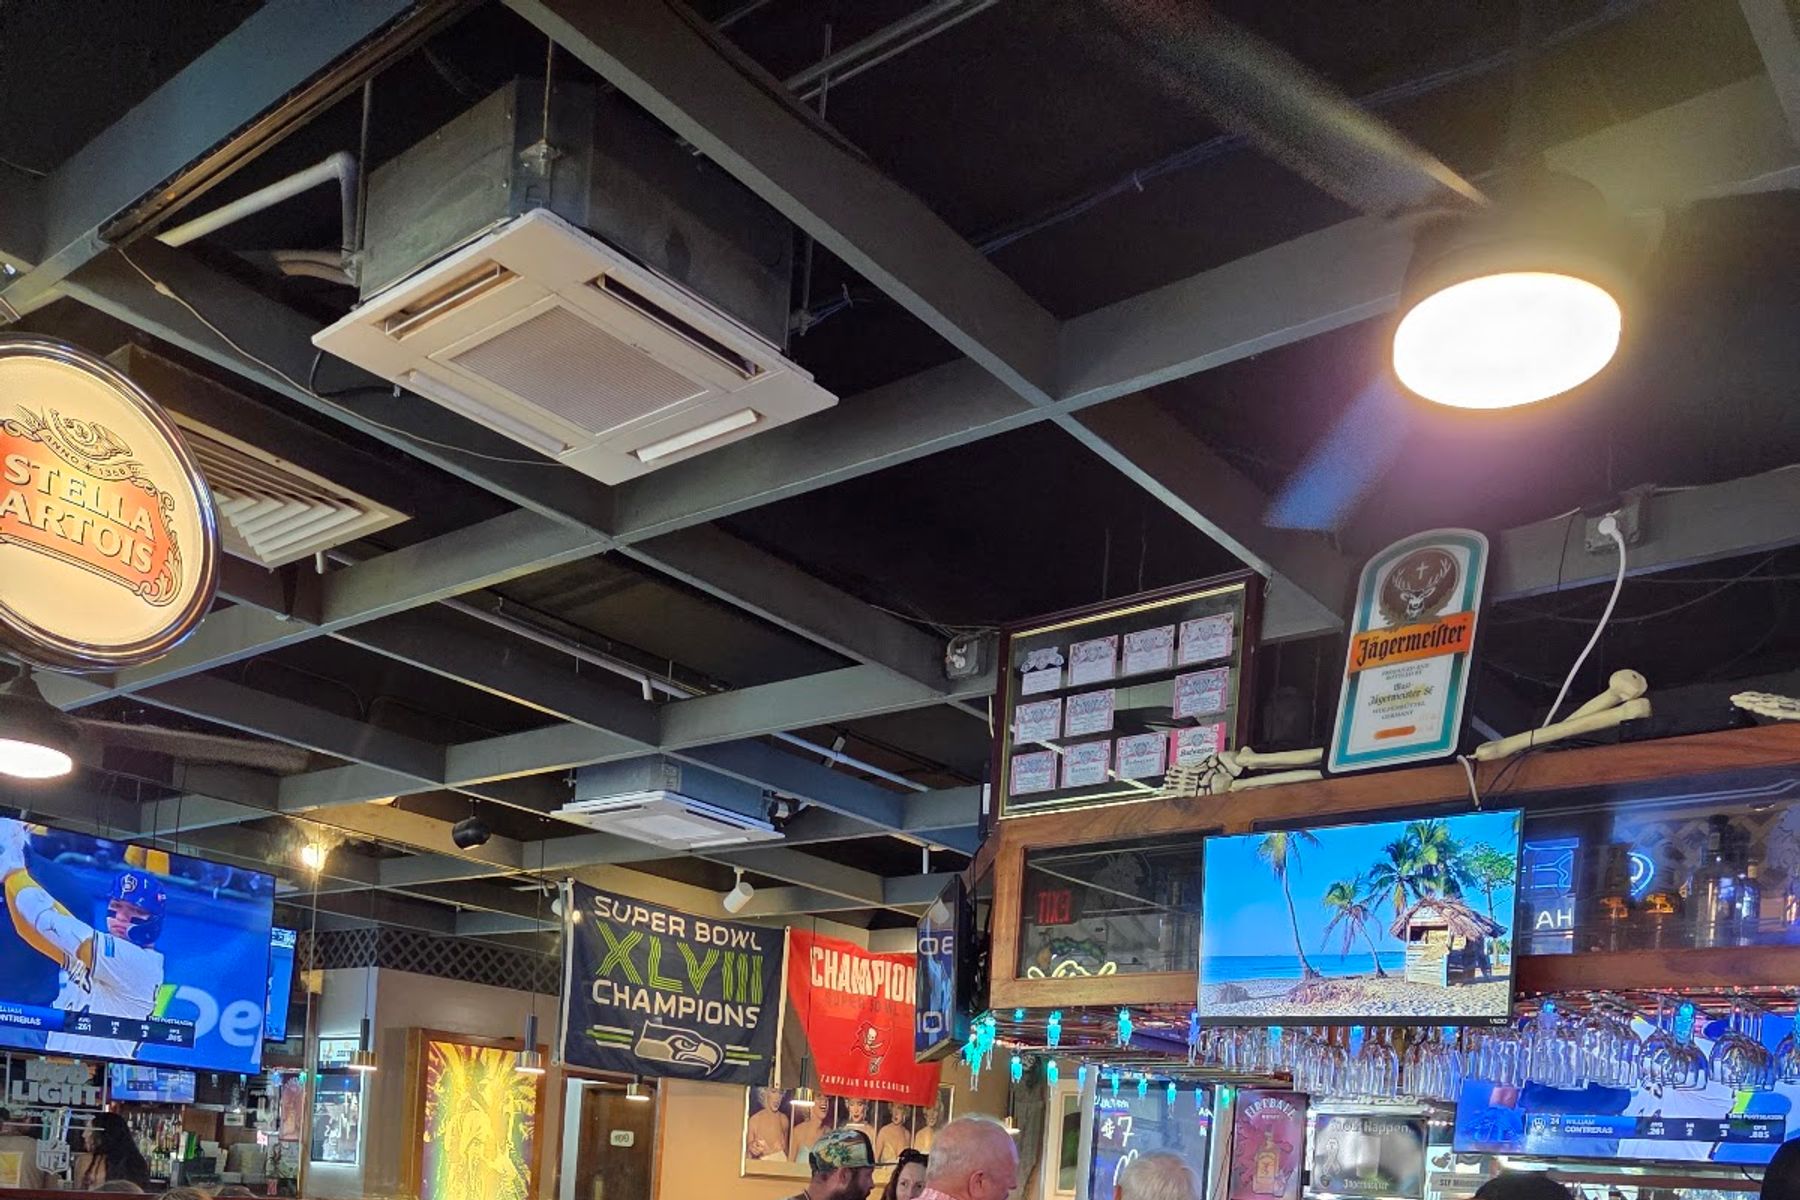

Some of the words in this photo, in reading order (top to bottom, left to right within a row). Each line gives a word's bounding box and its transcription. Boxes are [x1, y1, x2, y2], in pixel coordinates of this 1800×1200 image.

[4, 453, 156, 543] STELLA
[0, 489, 154, 574] ARTOIS
[594, 895, 686, 938] SUPER
[695, 920, 762, 951] BOWL
[595, 919, 764, 1006] XLVIII
[810, 945, 916, 1006] CHAMPION
[591, 979, 761, 1029] CHAMPIONS
[12, 1079, 100, 1106] LIGHT
[1244, 1097, 1297, 1121] FIREBALL
